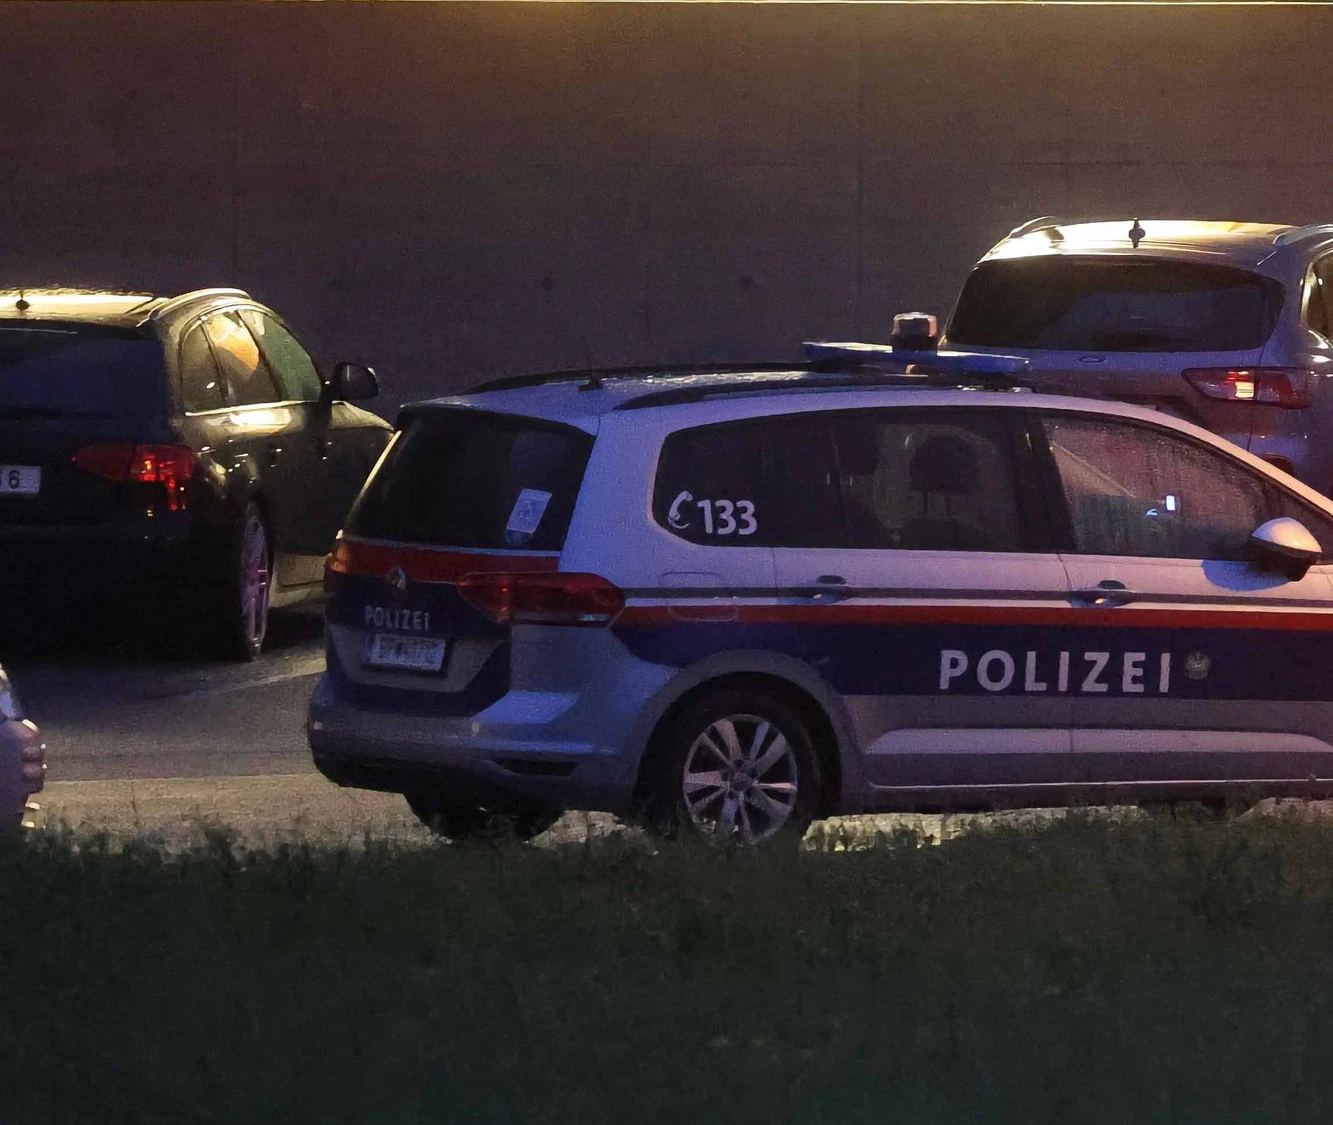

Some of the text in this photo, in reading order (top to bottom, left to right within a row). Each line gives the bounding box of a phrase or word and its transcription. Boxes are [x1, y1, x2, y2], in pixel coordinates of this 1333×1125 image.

[696, 499, 758, 535] 133
[363, 604, 432, 632] POLIZEI
[939, 649, 1172, 693] POLIZEI
